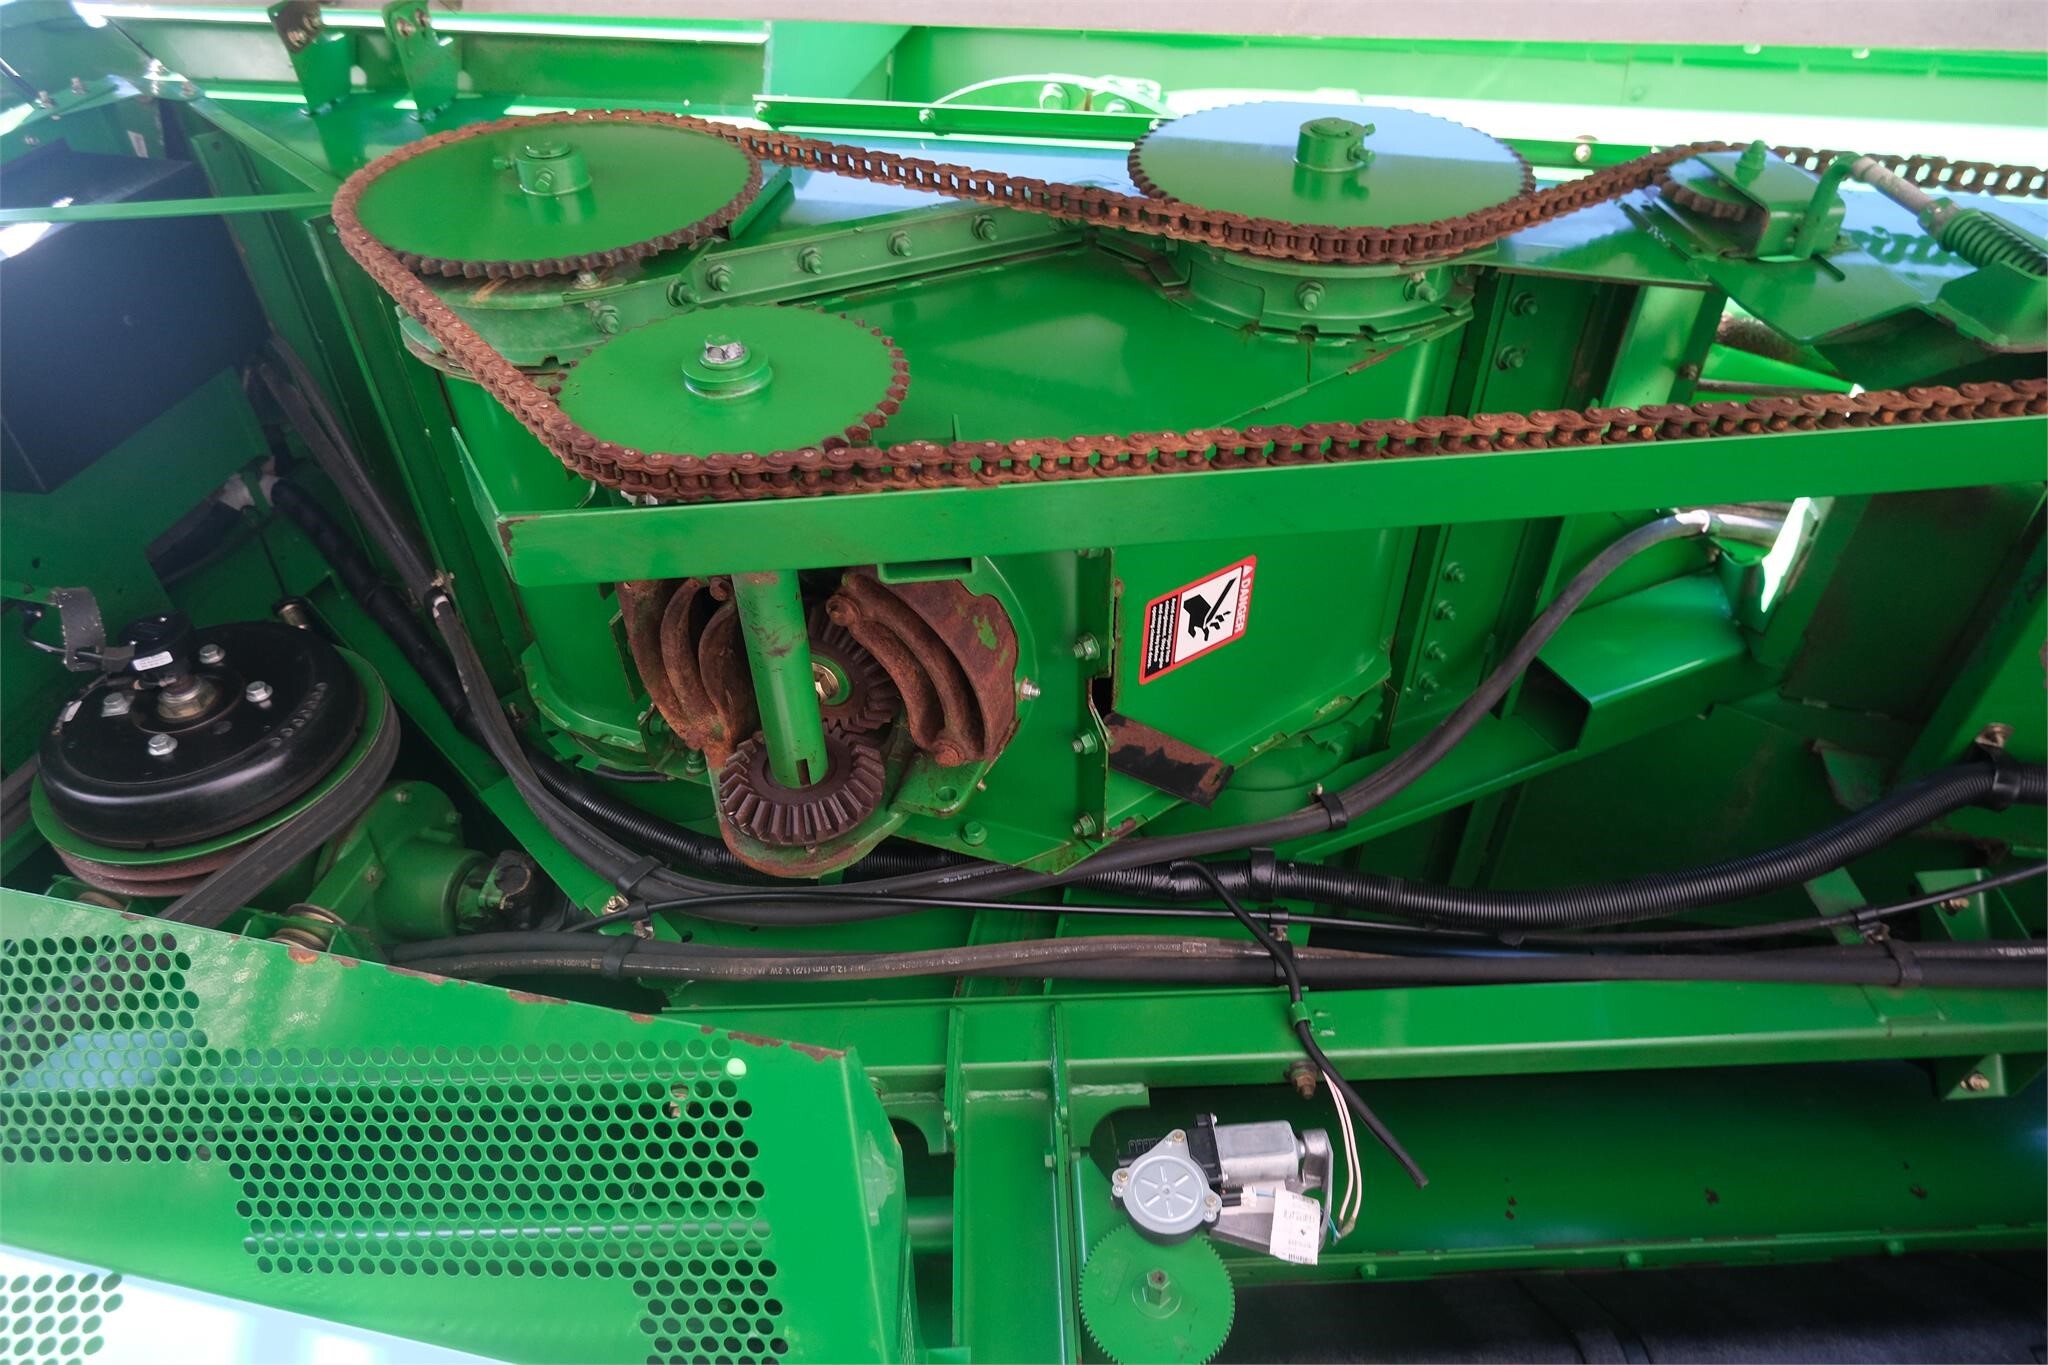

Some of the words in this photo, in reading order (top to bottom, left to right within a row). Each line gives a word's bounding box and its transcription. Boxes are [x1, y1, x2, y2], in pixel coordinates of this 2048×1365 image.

[1234, 577, 1251, 634] DANGER
[812, 965, 829, 974] mm
[830, 965, 848, 974] 12.5
